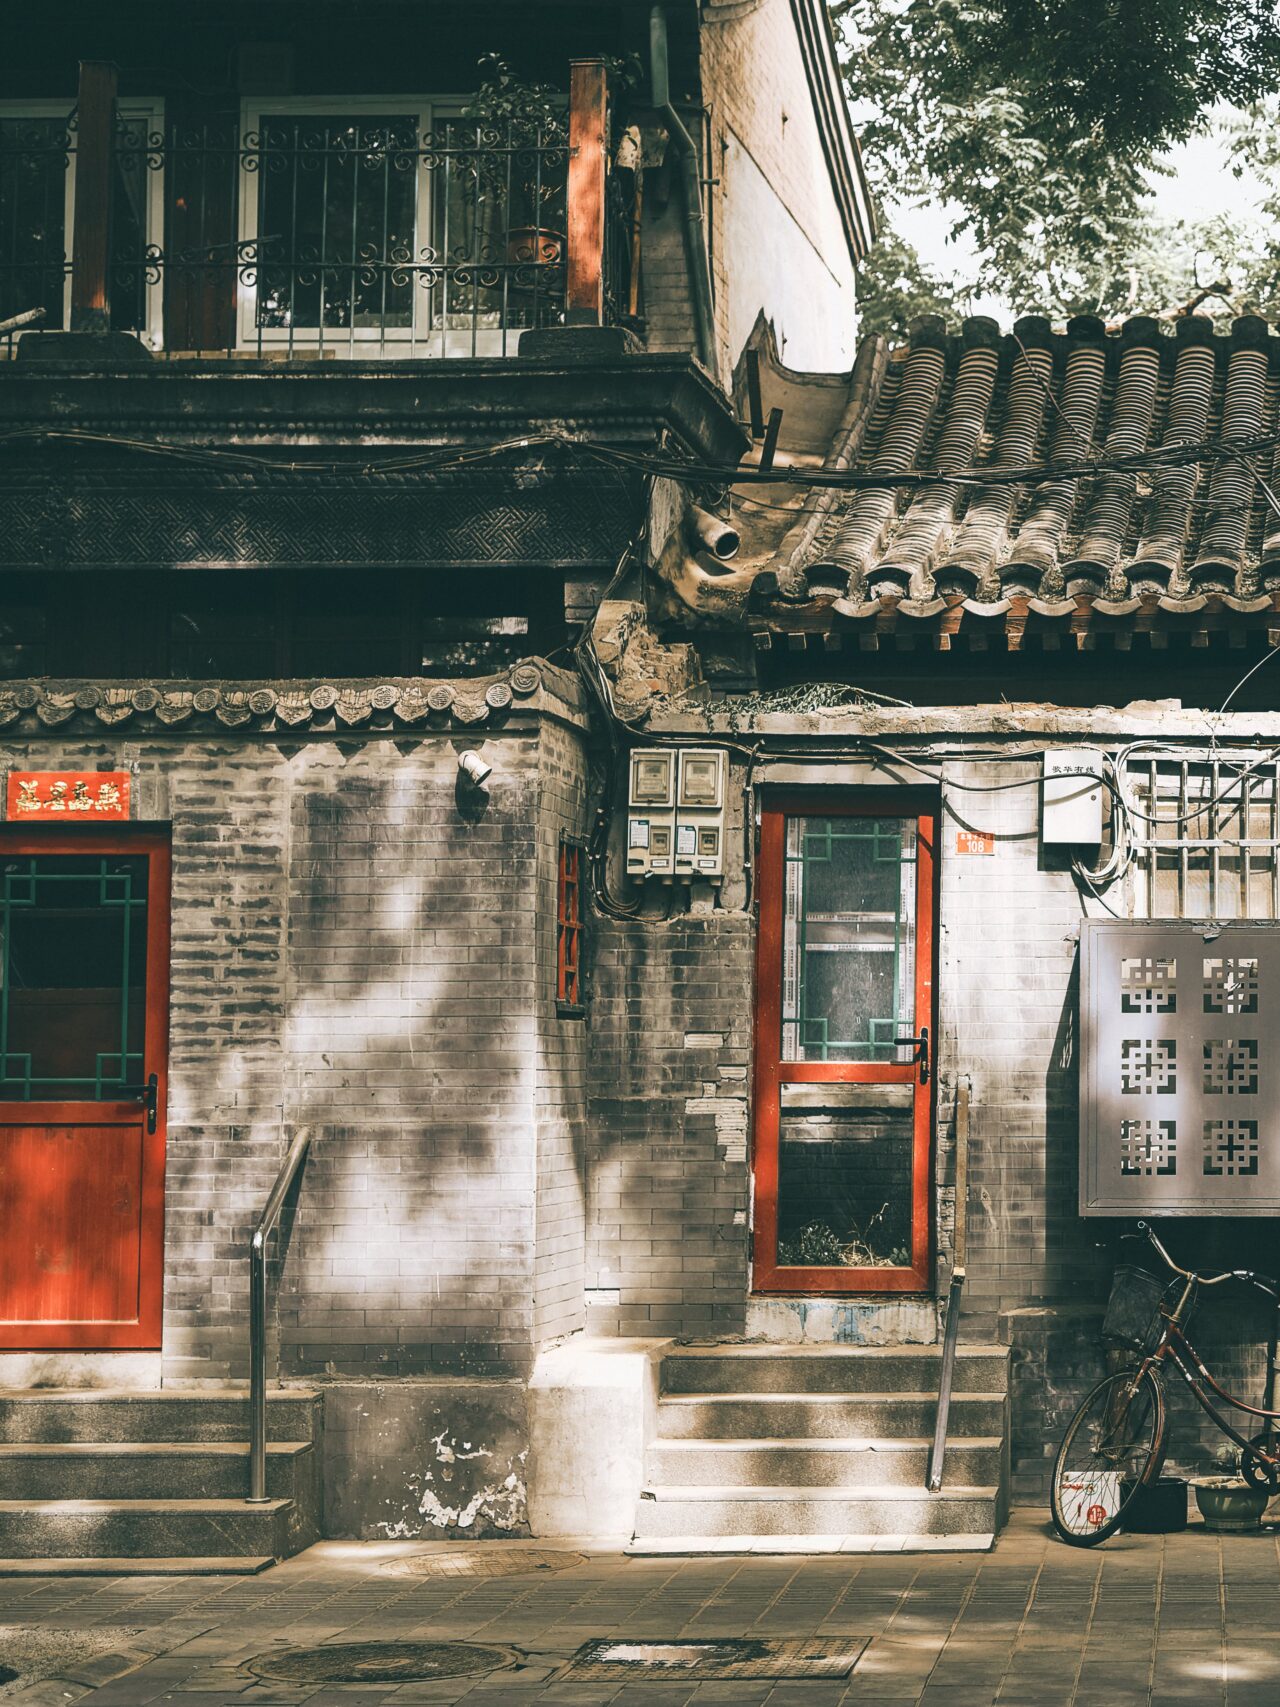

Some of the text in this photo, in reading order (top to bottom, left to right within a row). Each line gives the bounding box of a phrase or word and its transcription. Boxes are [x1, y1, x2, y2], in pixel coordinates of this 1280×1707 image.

[1052, 765, 1096, 774] 歌华有线
[966, 840, 985, 853] 108
